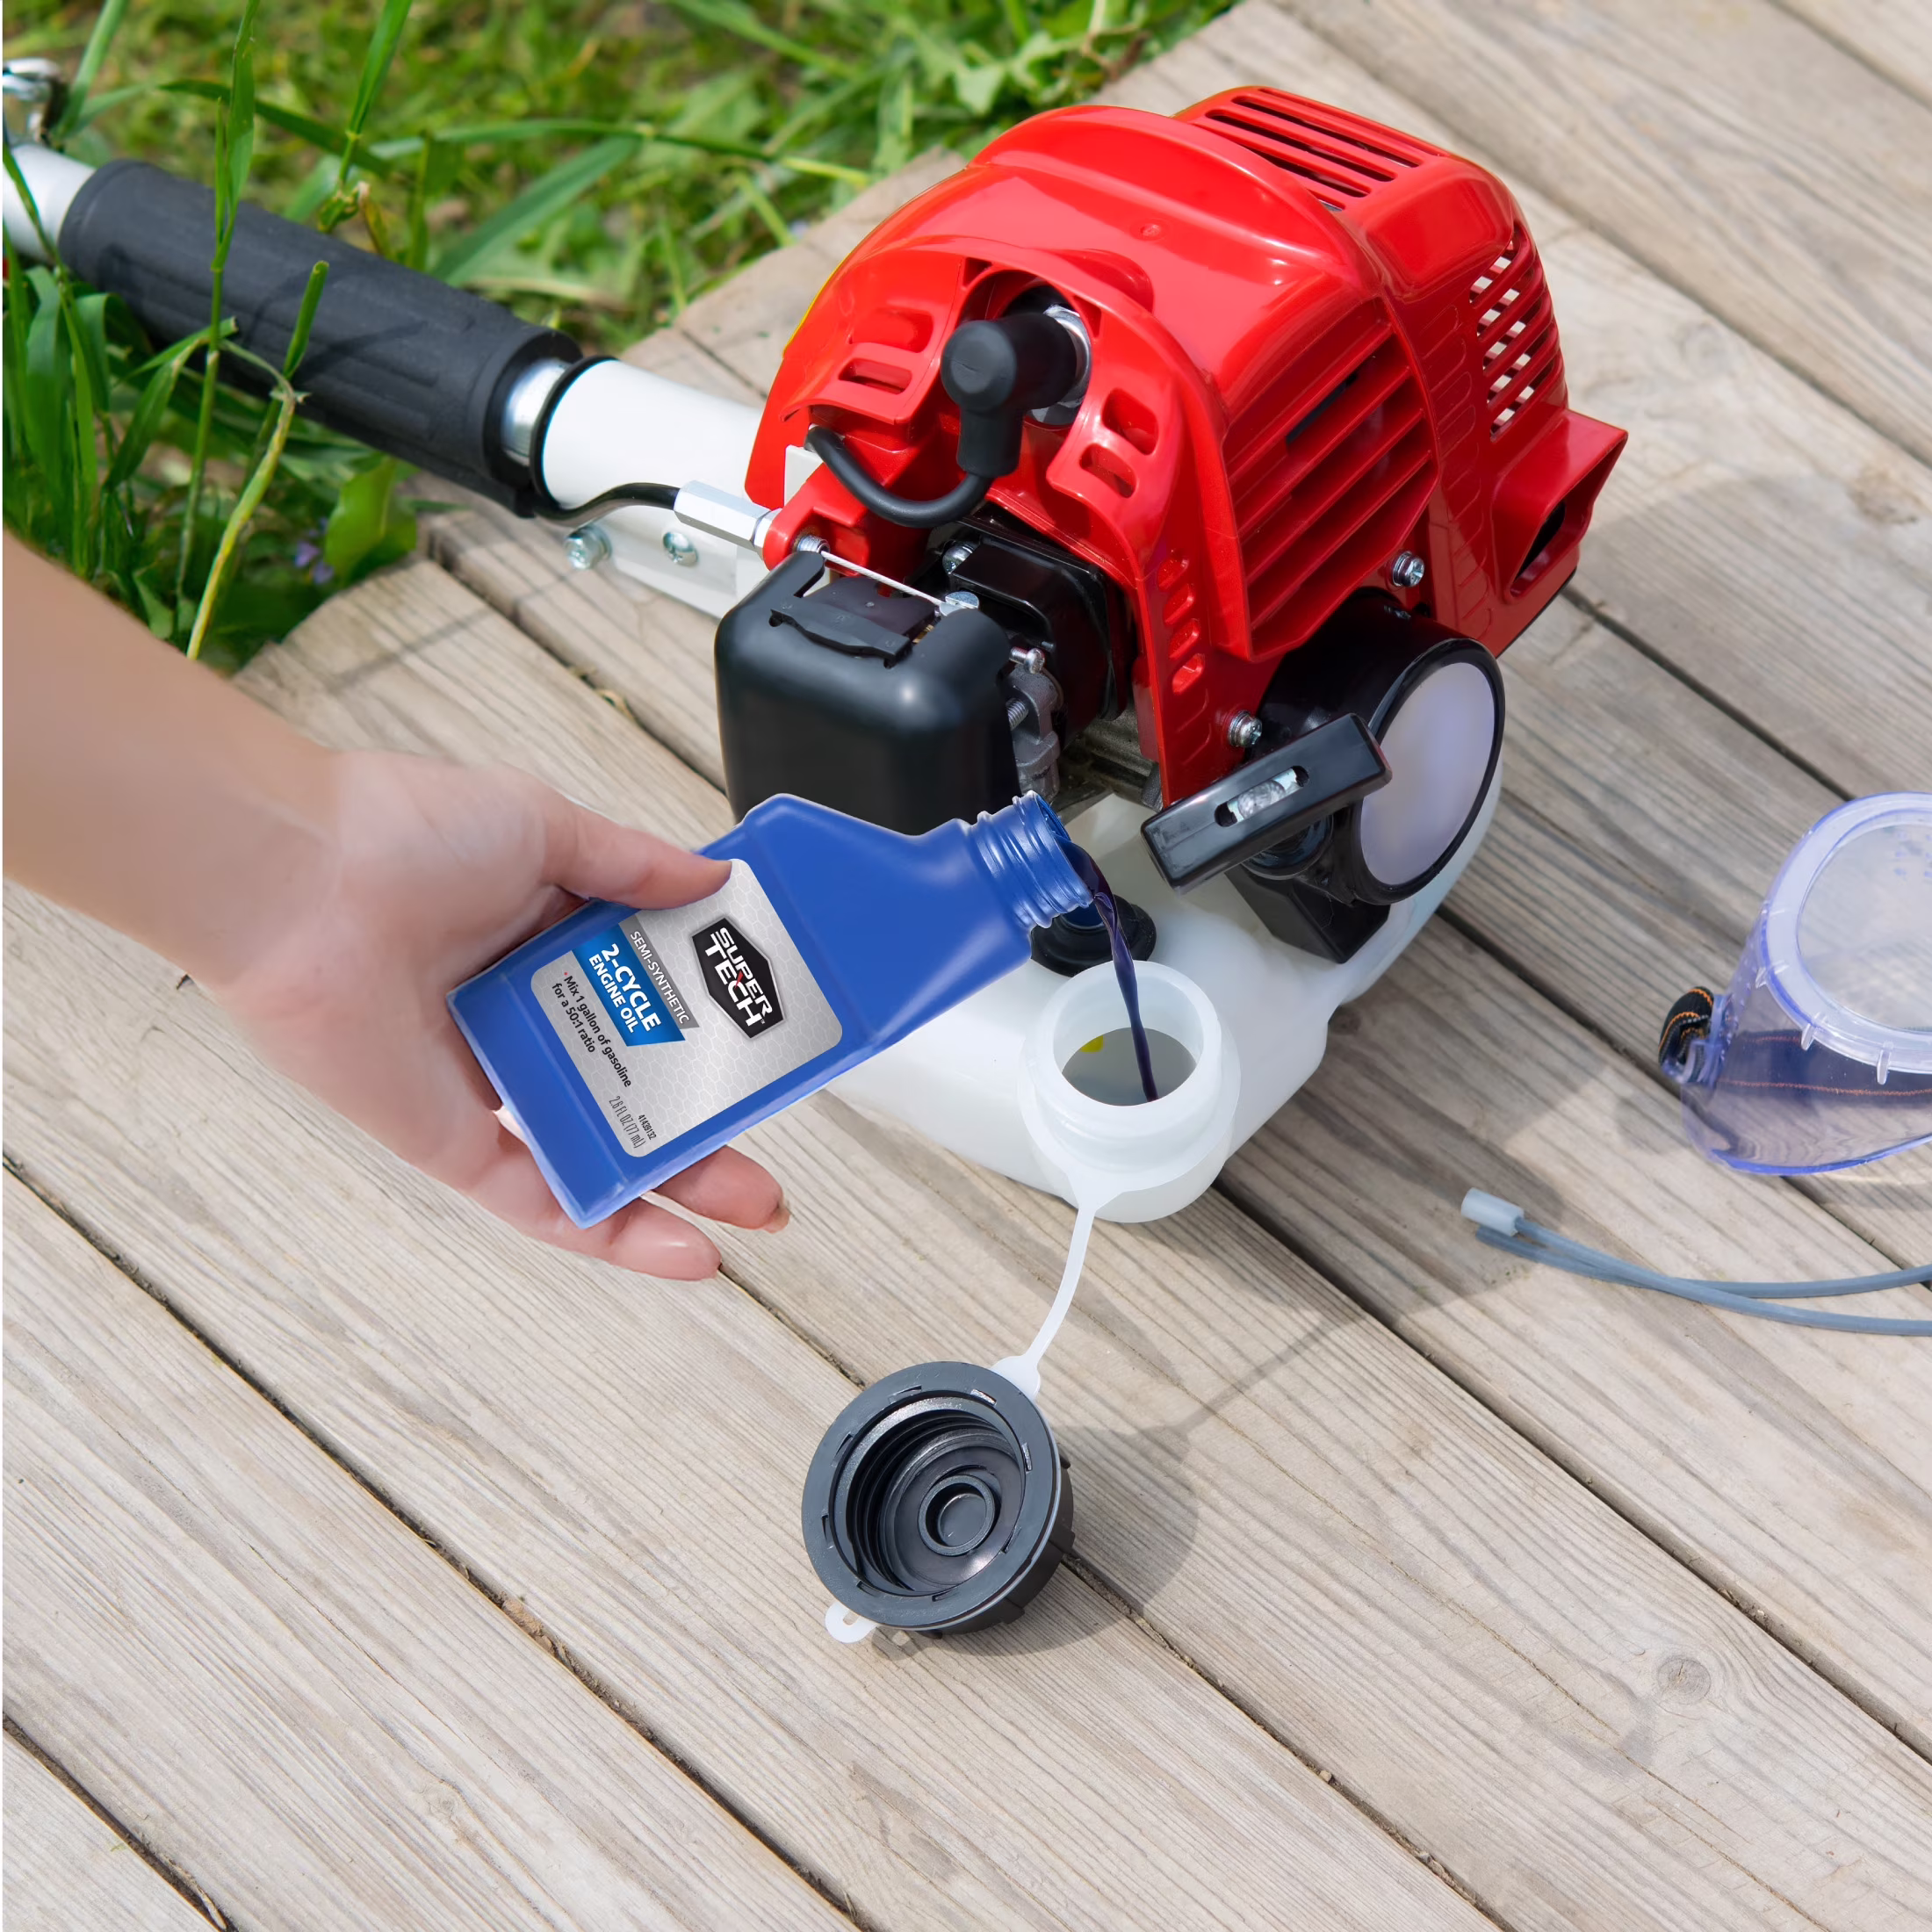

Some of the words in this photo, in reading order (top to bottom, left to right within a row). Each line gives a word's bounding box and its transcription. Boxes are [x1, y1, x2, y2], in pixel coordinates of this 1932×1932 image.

[564, 975, 580, 997] Mix
[601, 943, 662, 1032] 2-CYCLE
[630, 931, 690, 1024] SEMI-SYNTHETIC
[704, 933, 762, 1027] TECH
[715, 927, 773, 1017] SUPER
[575, 995, 585, 1004] 1
[588, 954, 626, 1008] ENGINE
[620, 1007, 639, 1033] OIL
[551, 983, 566, 998] for
[566, 1006, 584, 1028] 50:1
[577, 1028, 595, 1053] ratio
[576, 1003, 601, 1034] gallon
[597, 1034, 611, 1045] of
[602, 1046, 631, 1087] gasoline
[609, 1095, 624, 1109] 2.6
[615, 1106, 628, 1117] FL
[619, 1114, 634, 1127] OZ
